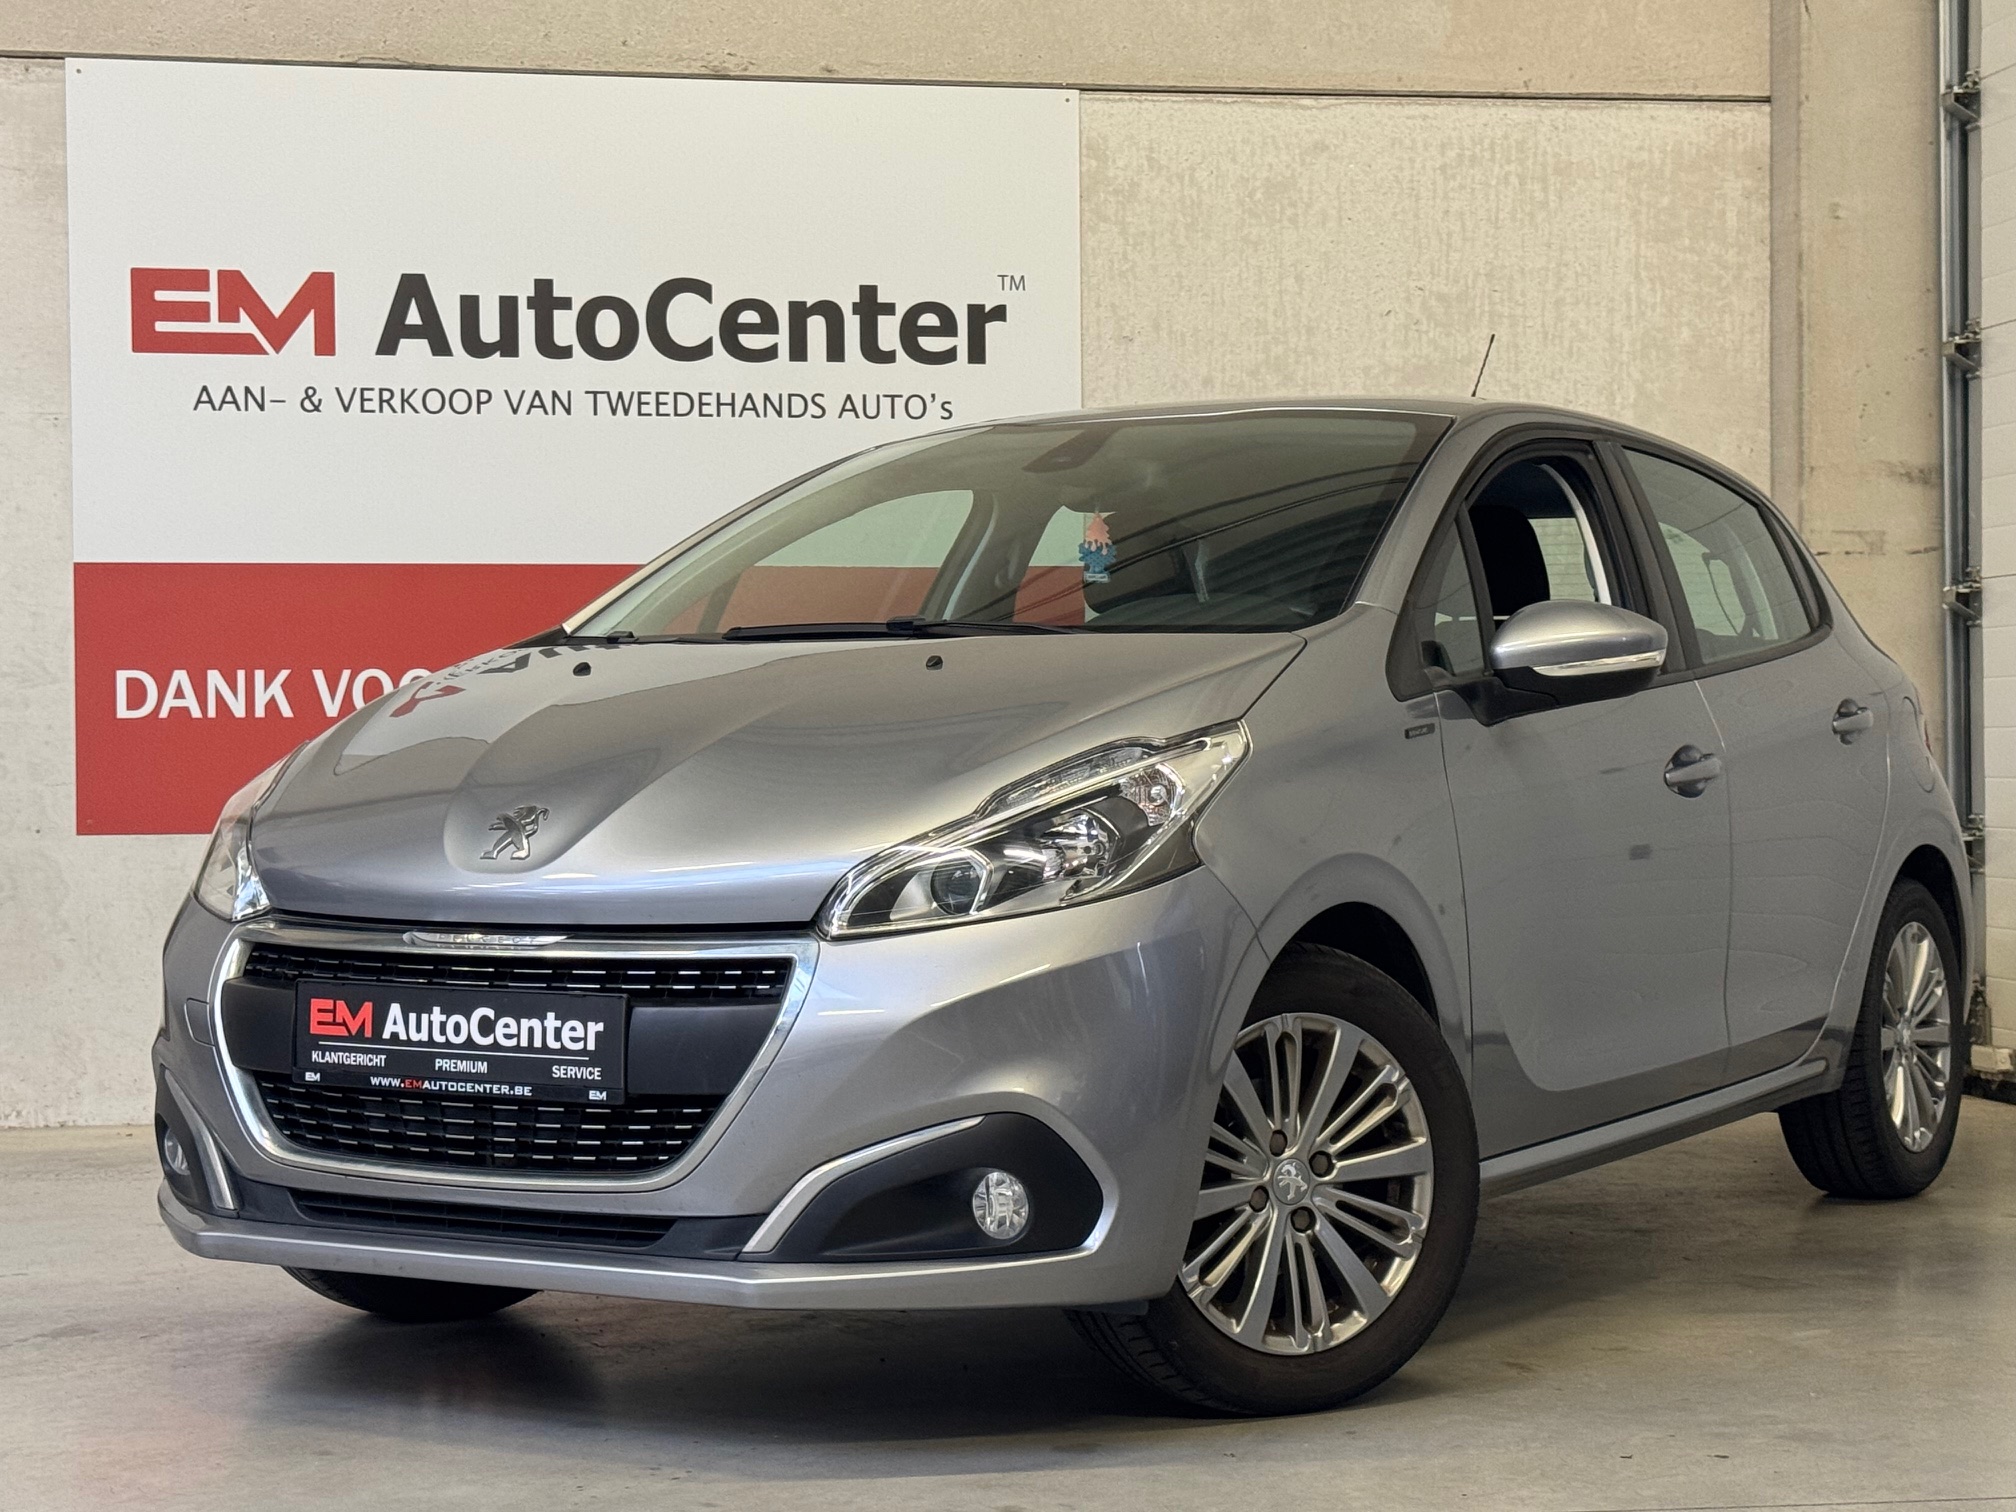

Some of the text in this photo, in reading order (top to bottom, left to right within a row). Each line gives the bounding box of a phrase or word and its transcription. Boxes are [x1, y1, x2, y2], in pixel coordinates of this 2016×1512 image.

[131, 267, 335, 356] EM
[375, 273, 1007, 366] AutoCenter
[299, 385, 323, 414] &
[334, 386, 493, 415] VERKOOP
[503, 389, 572, 416] VAN
[584, 390, 827, 420] TWEEDEHANDS
[837, 393, 953, 421] AUTO's
[115, 669, 294, 719] DANK
[309, 997, 605, 1051] EM AutoCenter
[311, 1050, 602, 1081] KLANTGERICHT PREMIUM SERVICE
[369, 1075, 533, 1097] WWW.EMAUTOCENTER.BE
